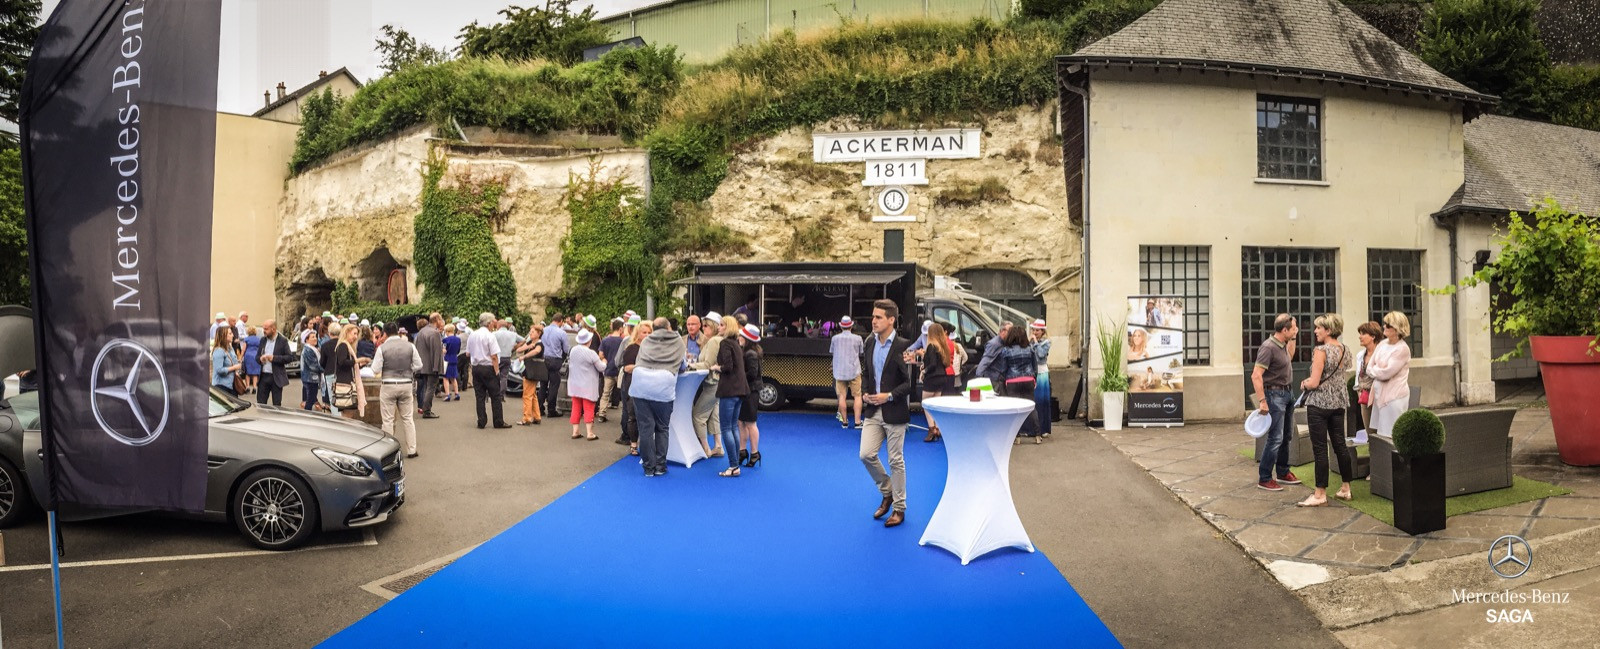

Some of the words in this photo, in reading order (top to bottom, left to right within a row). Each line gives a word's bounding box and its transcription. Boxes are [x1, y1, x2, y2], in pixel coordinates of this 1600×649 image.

[829, 136, 964, 155] ACKERMAN
[110, 0, 145, 311] Mercedes-Ben
[873, 162, 918, 178] 1811
[812, 284, 851, 292] ACKERMA
